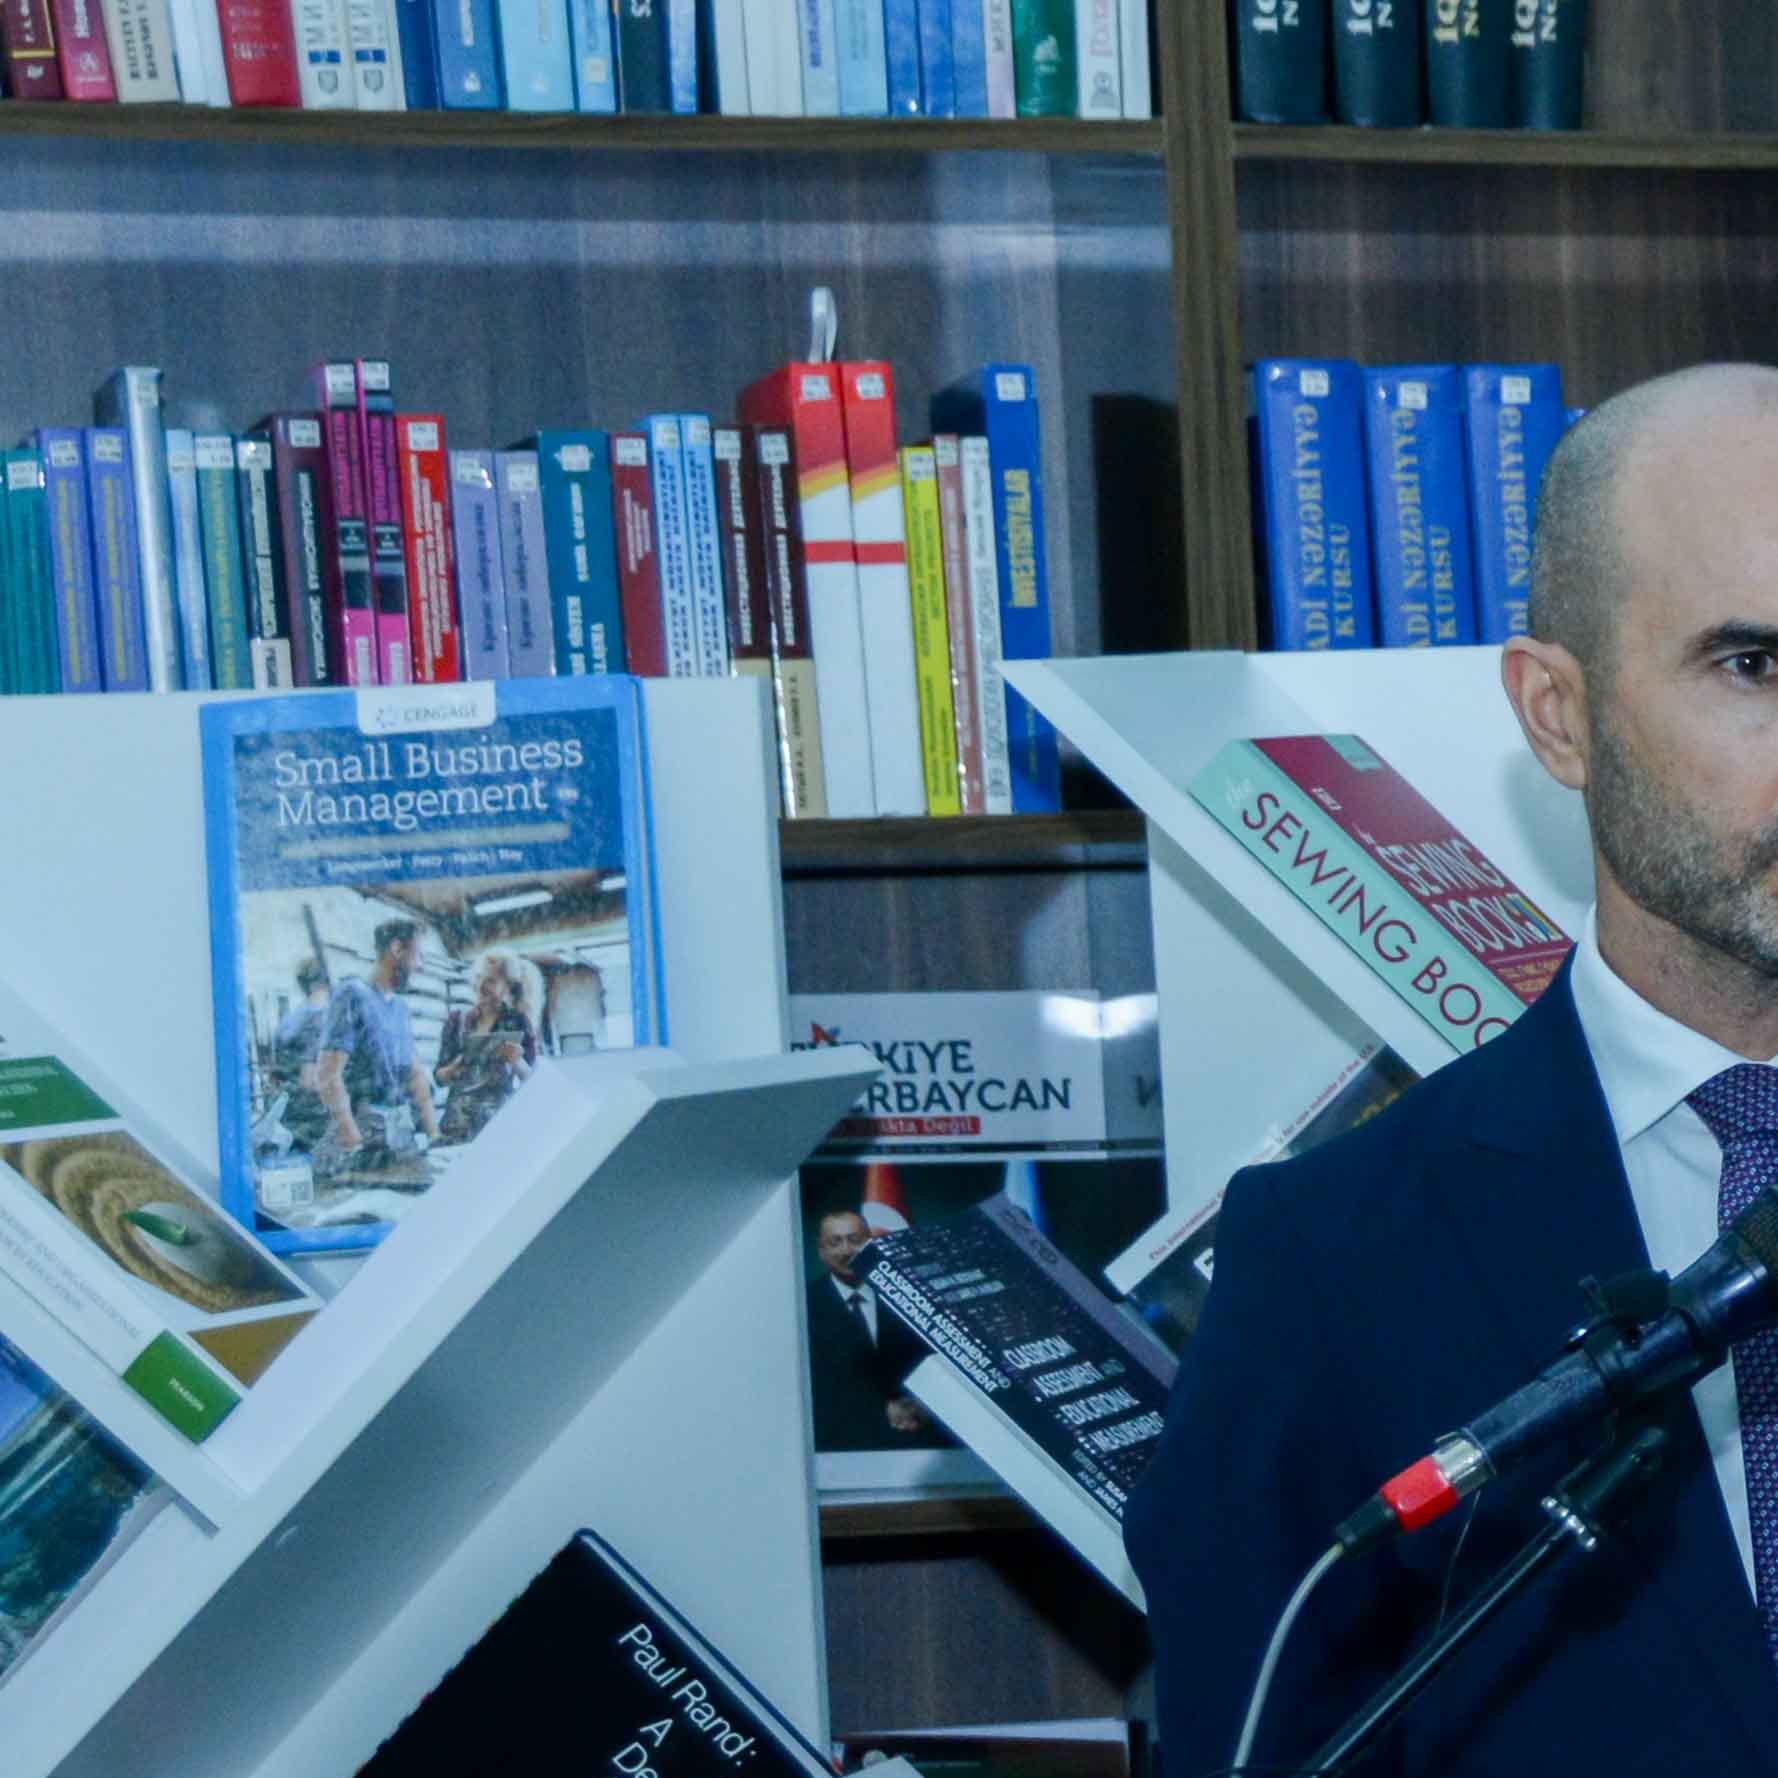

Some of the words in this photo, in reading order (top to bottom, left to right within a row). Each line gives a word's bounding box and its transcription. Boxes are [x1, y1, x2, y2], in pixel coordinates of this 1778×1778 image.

[274, 742, 393, 790] Small
[403, 735, 584, 780] Business
[275, 777, 549, 830] Management
[1380, 839, 1506, 896] SEWING
[1241, 791, 1418, 964] SEWING
[1411, 955, 1513, 1050] BOO
[869, 1269, 932, 1331] EDUCATIONAL
[930, 1326, 997, 1394] MEASUREMENT
[879, 1260, 935, 1317] CLASSROOM
[933, 1313, 990, 1369] ASSESSMENT
[618, 1623, 680, 1694] Paul
[671, 1674, 760, 1768] Rand:
[642, 1716, 673, 1748] A
